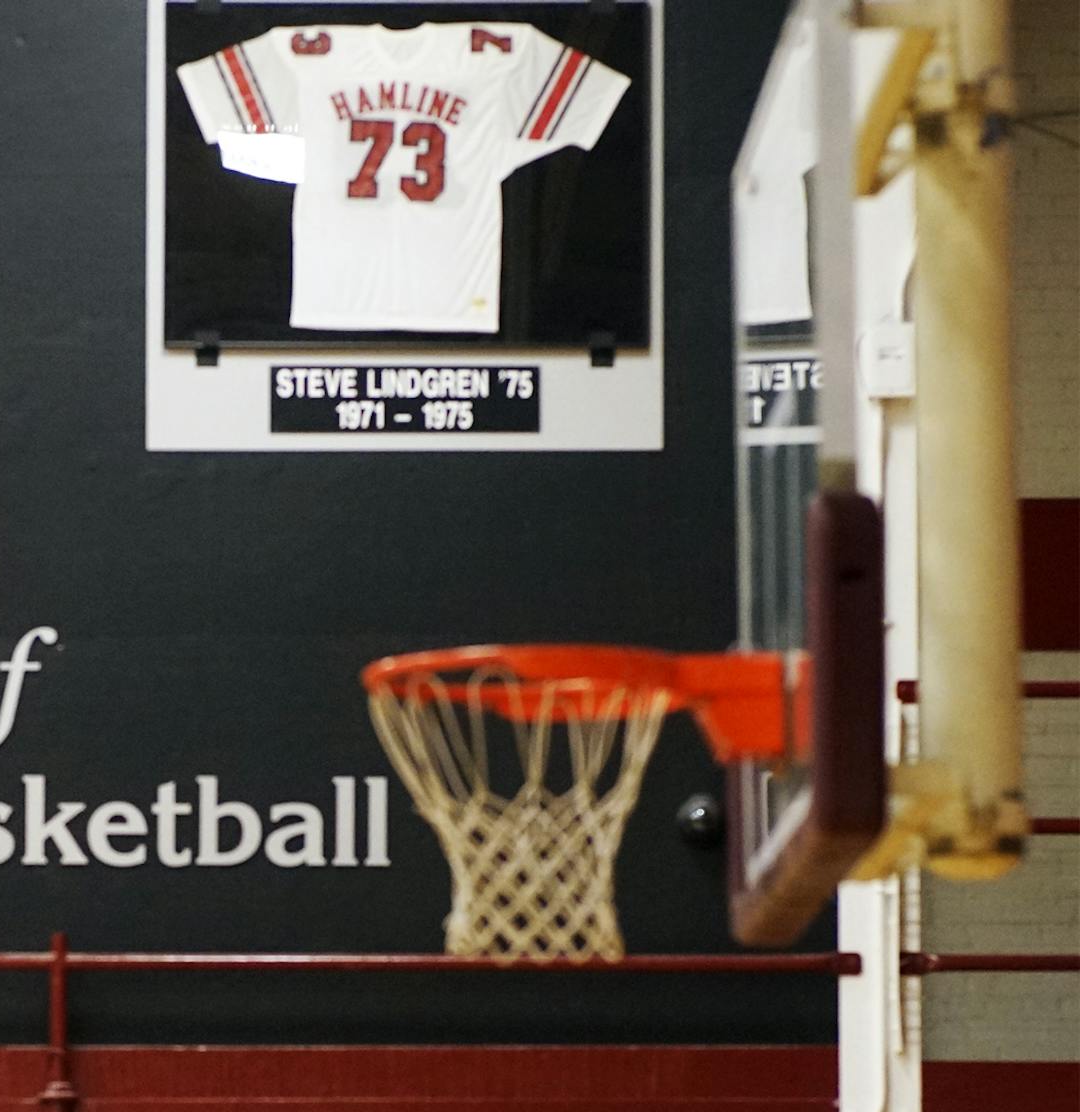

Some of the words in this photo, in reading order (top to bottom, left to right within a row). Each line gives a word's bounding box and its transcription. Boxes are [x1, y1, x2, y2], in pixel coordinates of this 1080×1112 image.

[330, 81, 467, 126] HAMLINE
[348, 119, 446, 202] 73
[276, 368, 358, 399] STEVE
[366, 368, 490, 399] LINDGREN
[497, 369, 534, 399] '75
[335, 401, 385, 430] 1971
[421, 401, 474, 430] 1975
